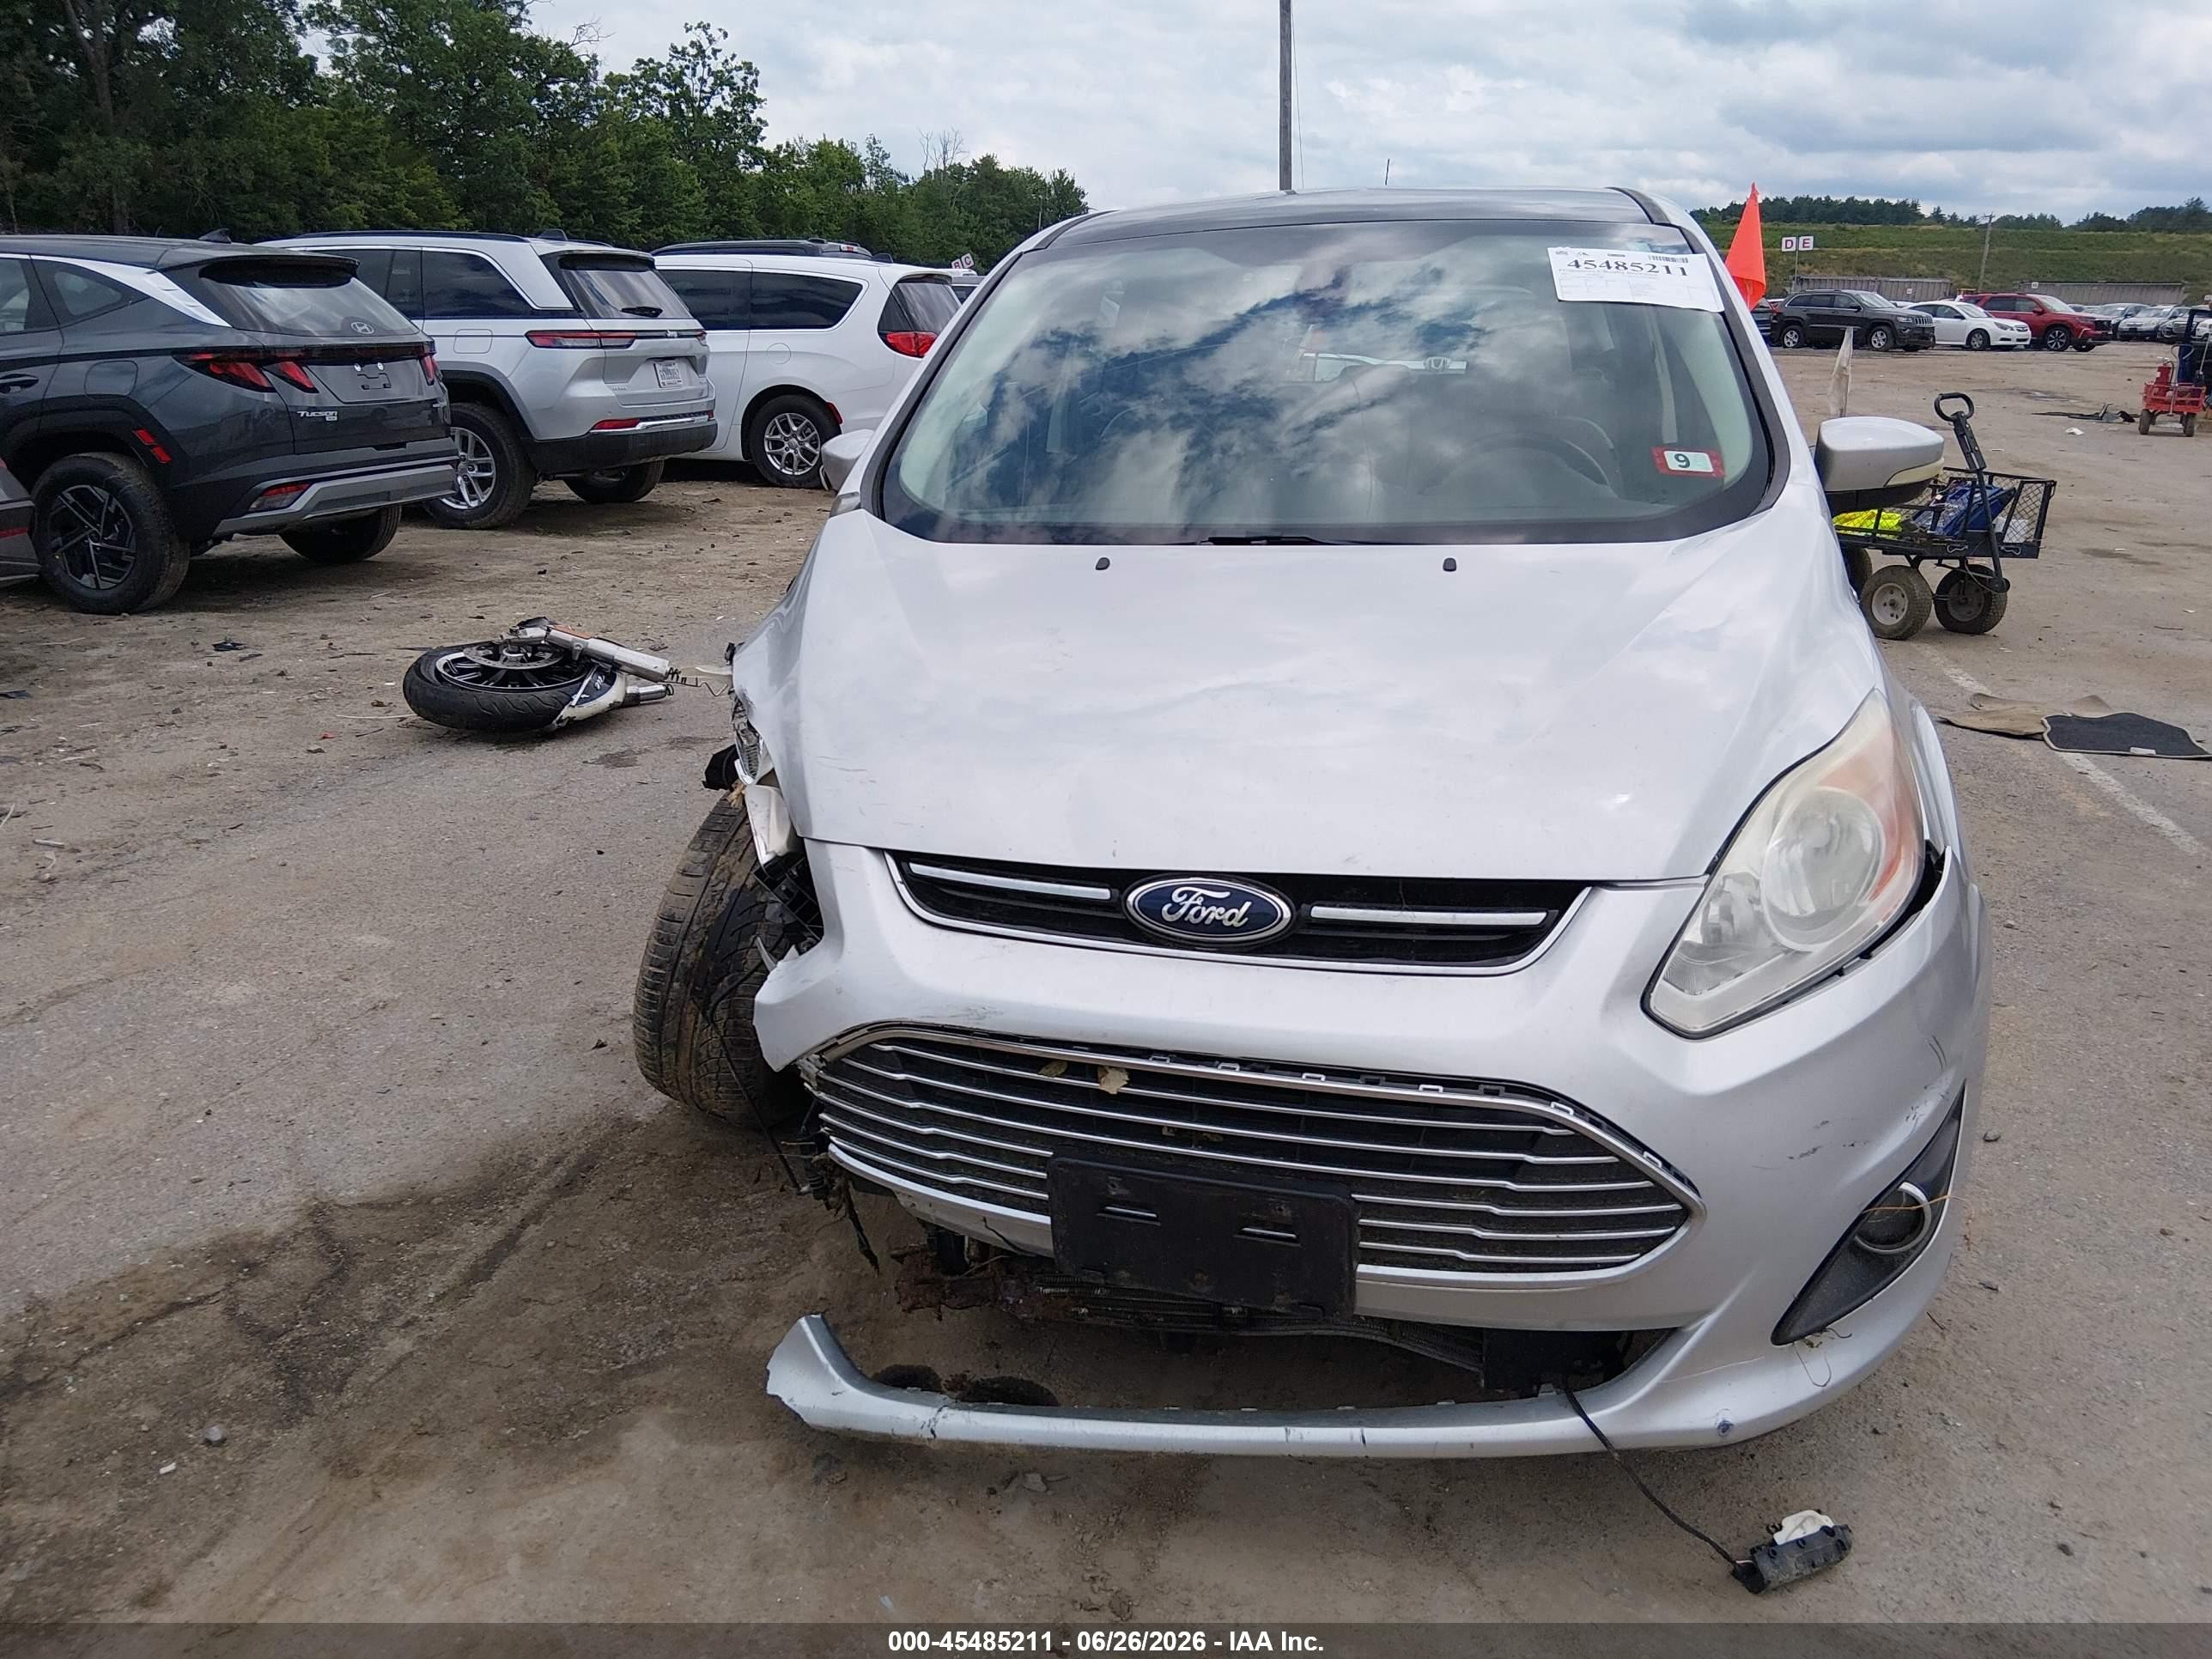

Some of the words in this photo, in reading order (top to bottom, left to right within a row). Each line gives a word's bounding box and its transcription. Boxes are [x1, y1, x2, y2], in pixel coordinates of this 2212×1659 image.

[1785, 240, 1793, 249] D
[1802, 239, 1810, 248] E
[1567, 259, 1688, 276] 45485211
[1674, 453, 1690, 468] 9
[1162, 887, 1252, 927] Ford
